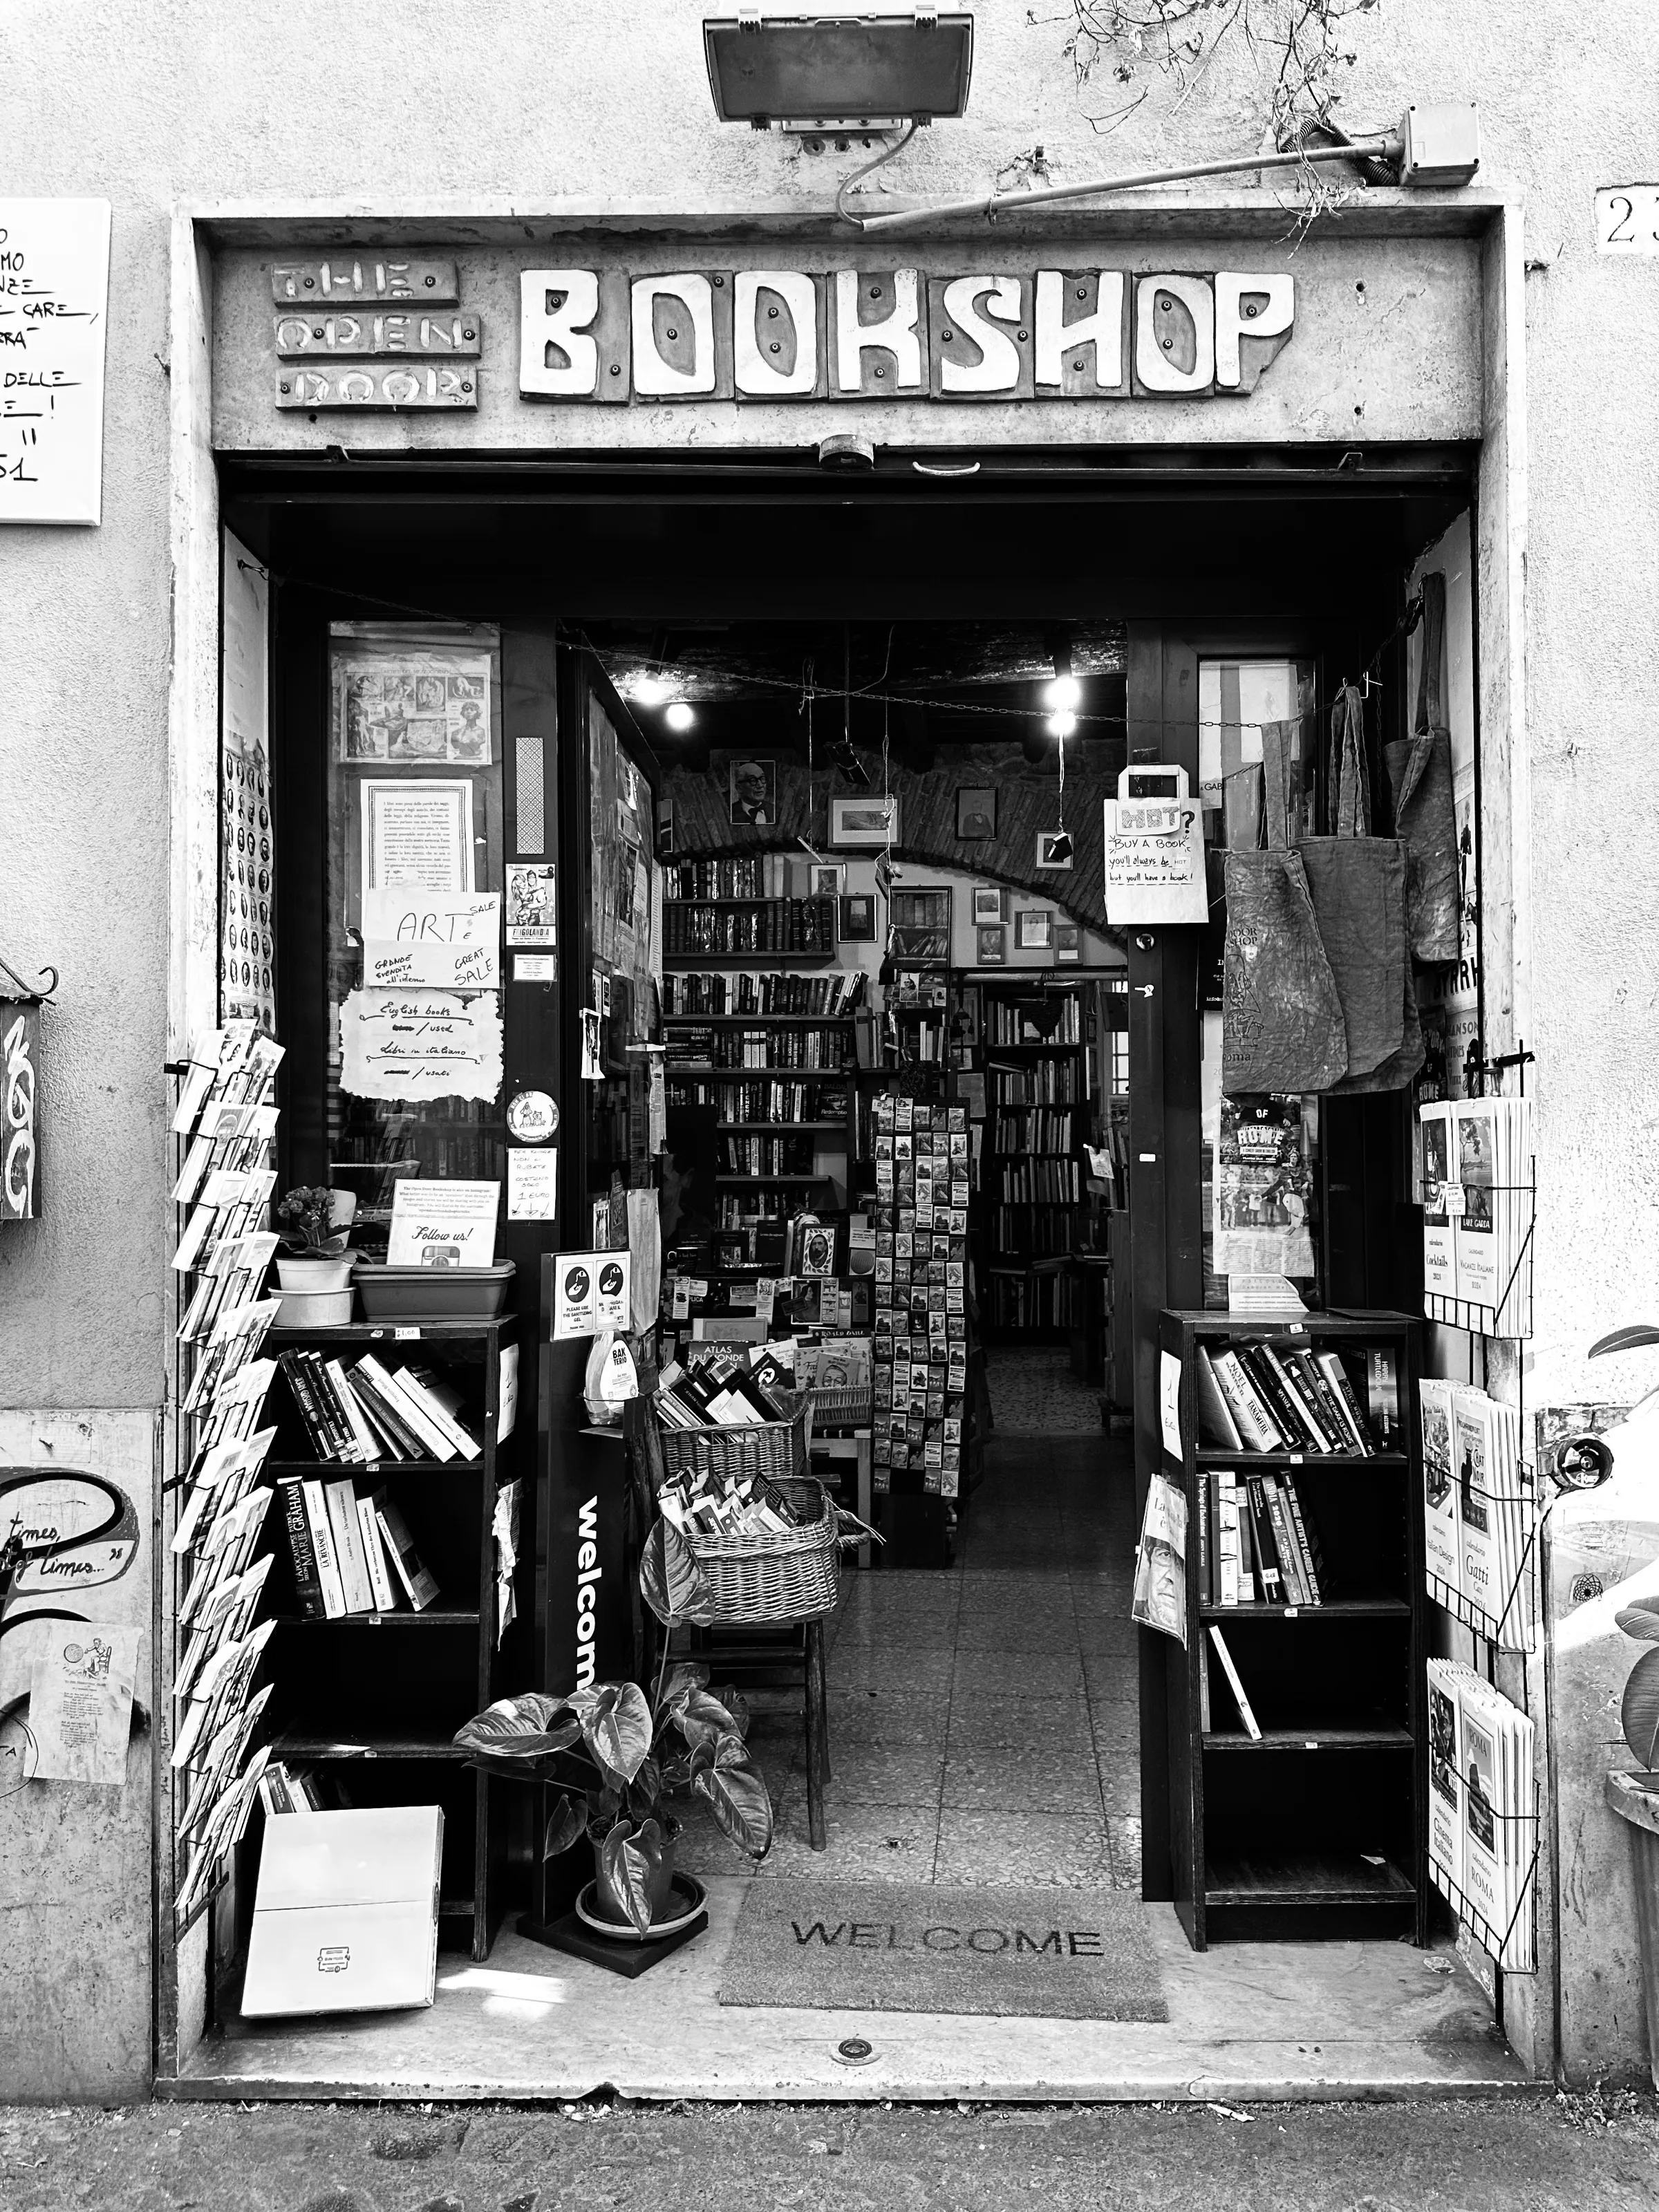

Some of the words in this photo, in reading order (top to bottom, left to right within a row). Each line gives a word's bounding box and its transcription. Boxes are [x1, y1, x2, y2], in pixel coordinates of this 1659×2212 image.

[1607, 196, 1659, 243] 2
[274, 262, 413, 297] THE
[276, 315, 463, 349] OPEN
[519, 268, 1295, 395] BOOKSHOP
[4, 371, 82, 387] DELLE
[294, 367, 463, 406] DOOR
[1114, 839, 1138, 850] BUY
[1143, 839, 1150, 847] A
[1156, 839, 1185, 848] BOOK
[1109, 854, 1130, 870] you'll
[1161, 856, 1169, 865] be
[1127, 873, 1141, 882] you'll
[469, 901, 496, 915] SALE
[397, 912, 474, 941] ART
[375, 954, 413, 969] GRANDE
[455, 947, 484, 969] GREAT
[376, 965, 412, 979] SVENDITA
[455, 958, 494, 985] SALE
[380, 1002, 418, 1019] English
[425, 1007, 451, 1017] books
[430, 1024, 453, 1033] used
[380, 1041, 406, 1054] Libri
[425, 1047, 466, 1056] italiano
[1256, 1109, 1268, 1118] OF
[1237, 1127, 1285, 1145] ROME
[517, 1192, 526, 1200] 1
[411, 1226, 451, 1240] Follow
[453, 1228, 474, 1241] us!
[1426, 1253, 1448, 1267] Cocktails
[612, 1347, 626, 1360] BAK
[1230, 1362, 1248, 1390] NOEL
[1248, 1400, 1269, 1435] TANAMERA
[1326, 1395, 1336, 1408] THE
[1331, 1405, 1344, 1422] DARK
[1198, 1488, 1206, 1503] Springs
[1266, 1482, 1277, 1503] INDIA
[1287, 1488, 1296, 1502] THE
[286, 1483, 306, 1532] GRAHAM
[1271, 1505, 1282, 1526] 2020
[1291, 1503, 1301, 1518] FINE
[10, 1511, 61, 1544] times,
[1294, 1519, 1308, 1548] ARTIST'S
[297, 1530, 313, 1567] MARIE
[317, 1528, 328, 1558] REVANCHE
[289, 1533, 304, 1582] L'APOCALYPSE
[322, 1559, 330, 1568] LA
[1301, 1548, 1313, 1574] CAREER
[1466, 1555, 1488, 1586] Gatti
[1308, 1574, 1319, 1595] GUIDE
[577, 1495, 602, 1719] welcom
[1468, 1727, 1489, 1758] ROMA
[1434, 1817, 1454, 1850] Cinema
[1434, 1832, 1454, 1866] Italiano
[1471, 1866, 1495, 1904] ROMA
[791, 1921, 1105, 1956] WELCOME
